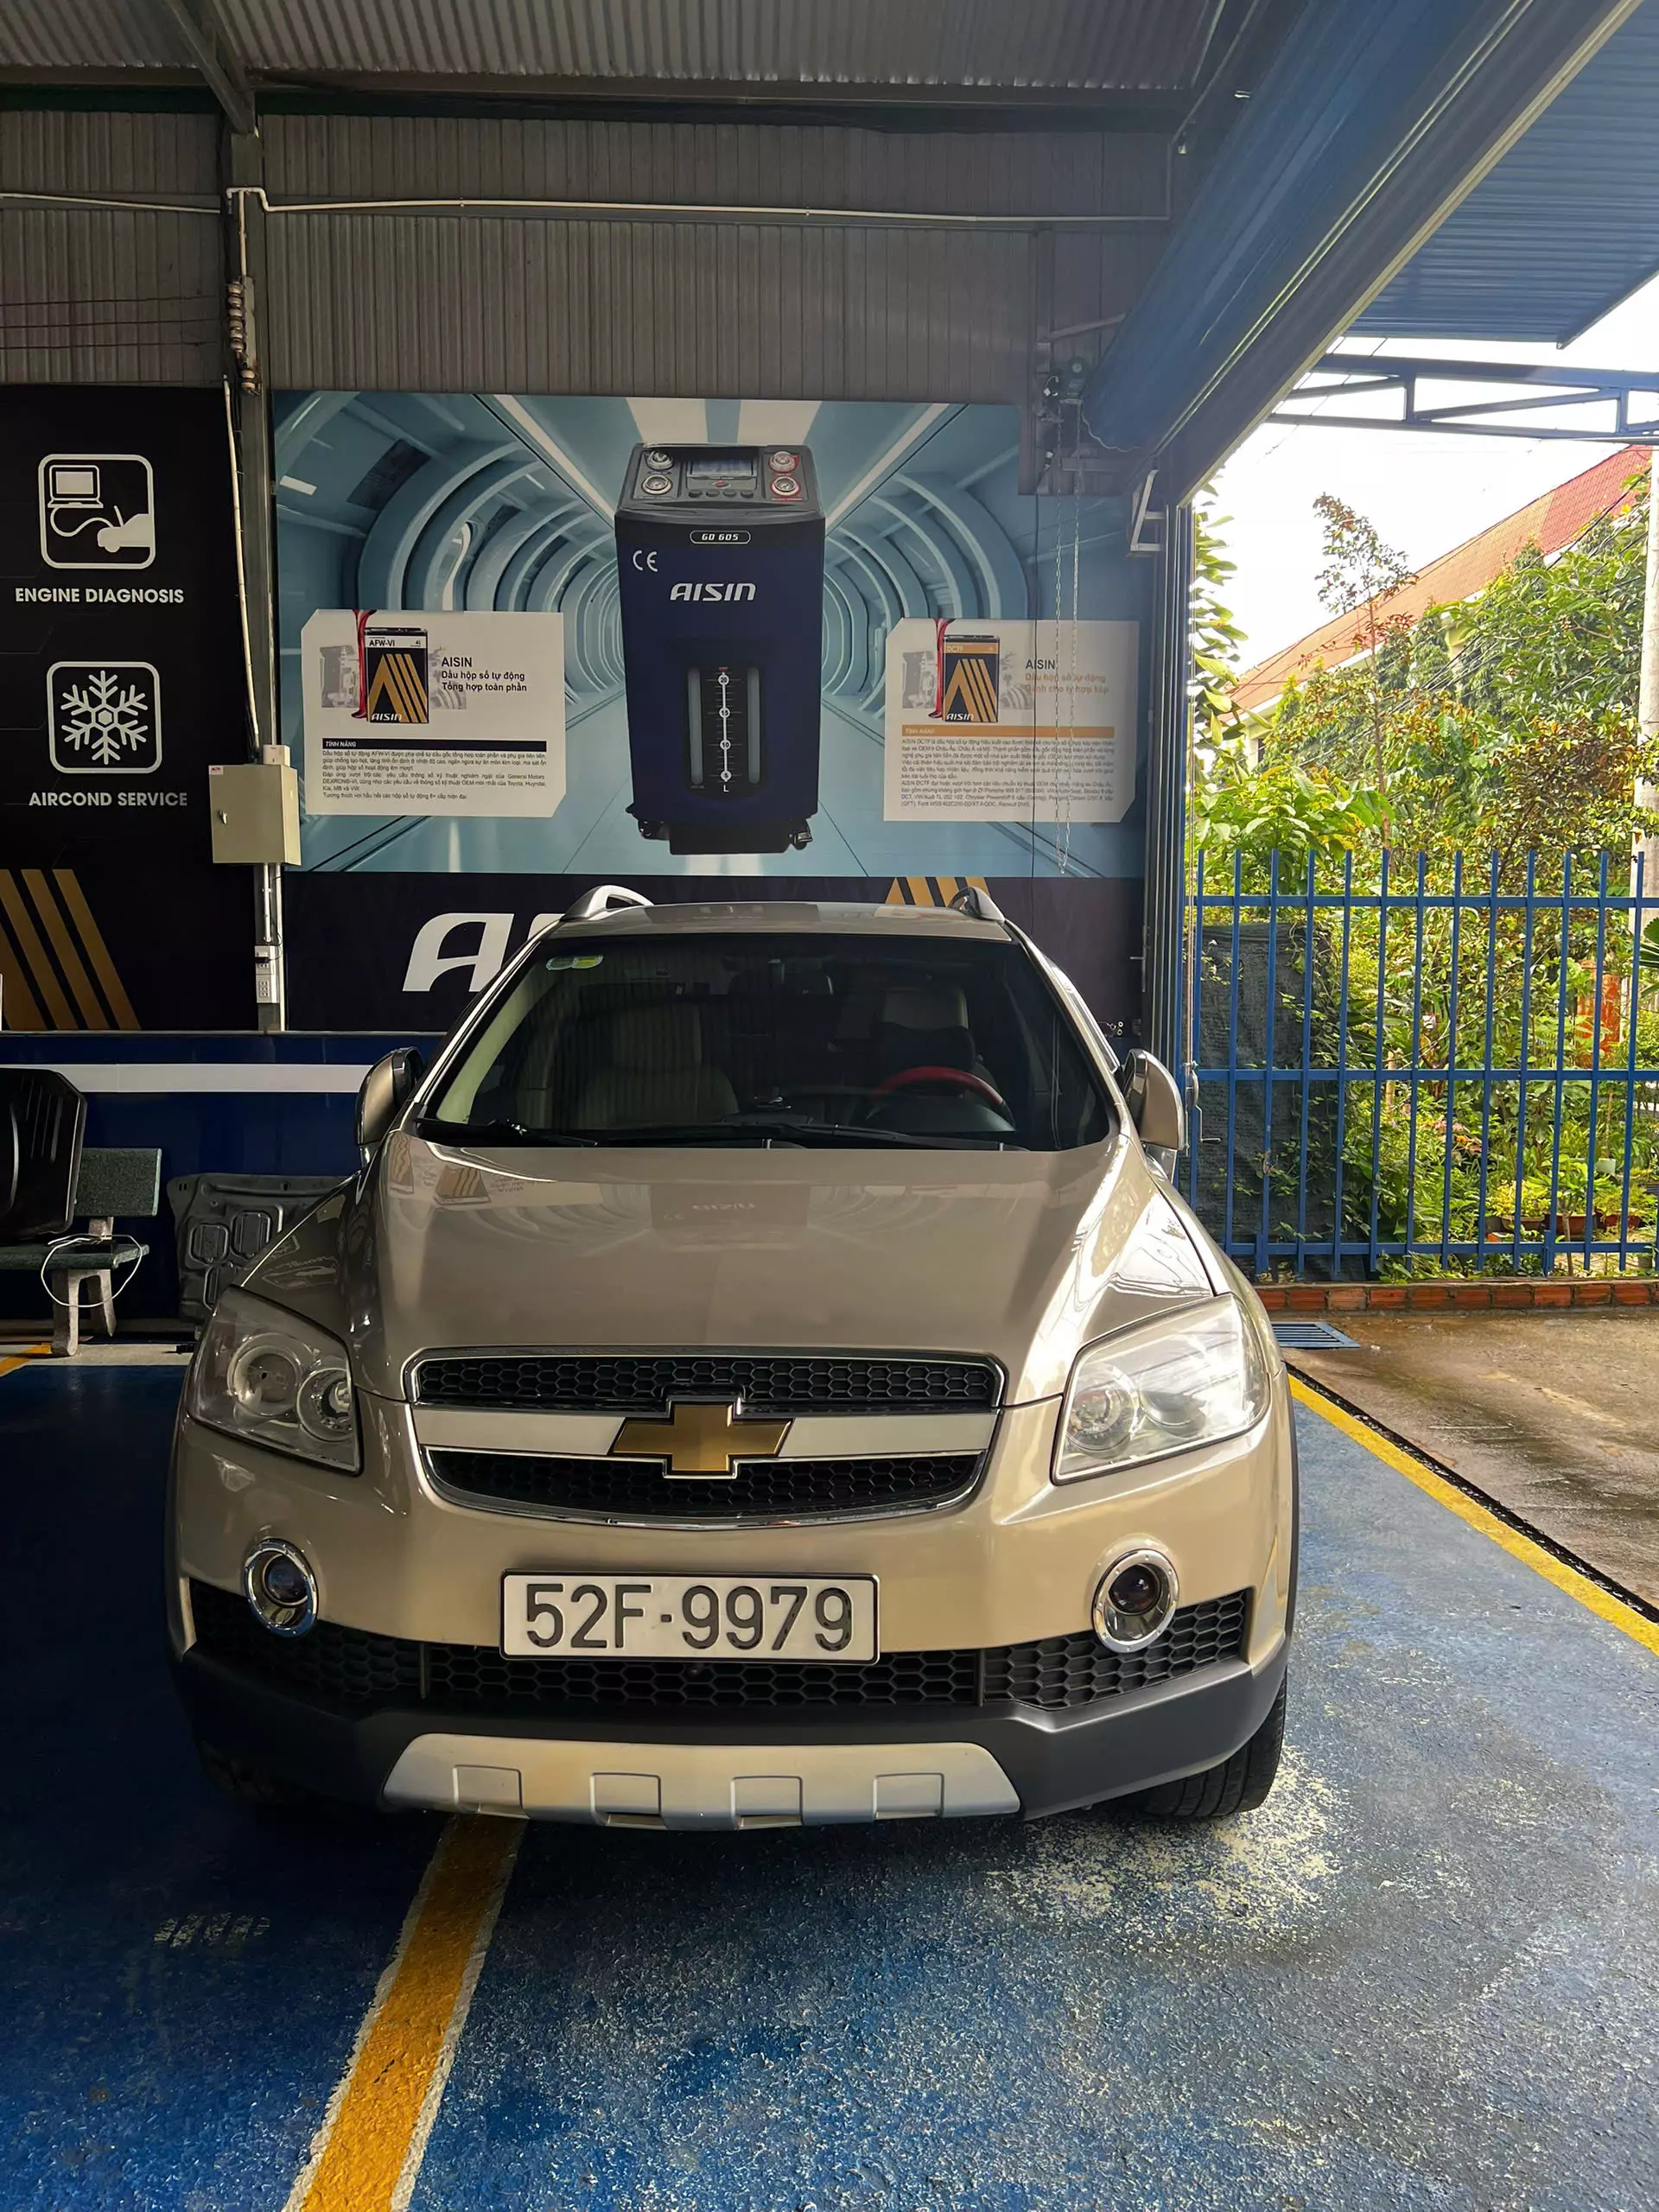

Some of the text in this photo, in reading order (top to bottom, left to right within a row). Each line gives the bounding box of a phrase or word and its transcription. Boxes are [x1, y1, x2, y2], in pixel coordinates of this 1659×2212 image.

[632, 550, 658, 572] CE
[15, 588, 184, 603] ENGINE DIAGNOSIS
[670, 582, 757, 601] AISIN
[441, 657, 473, 668] AISIN
[442, 670, 525, 682] Dầu hộp số tự động
[442, 681, 527, 693] Tổng hợp toàn phần
[371, 713, 402, 721] AISIN
[29, 792, 188, 806] AIRCOND SERVICE
[526, 1583, 854, 1652] 52F-9979
